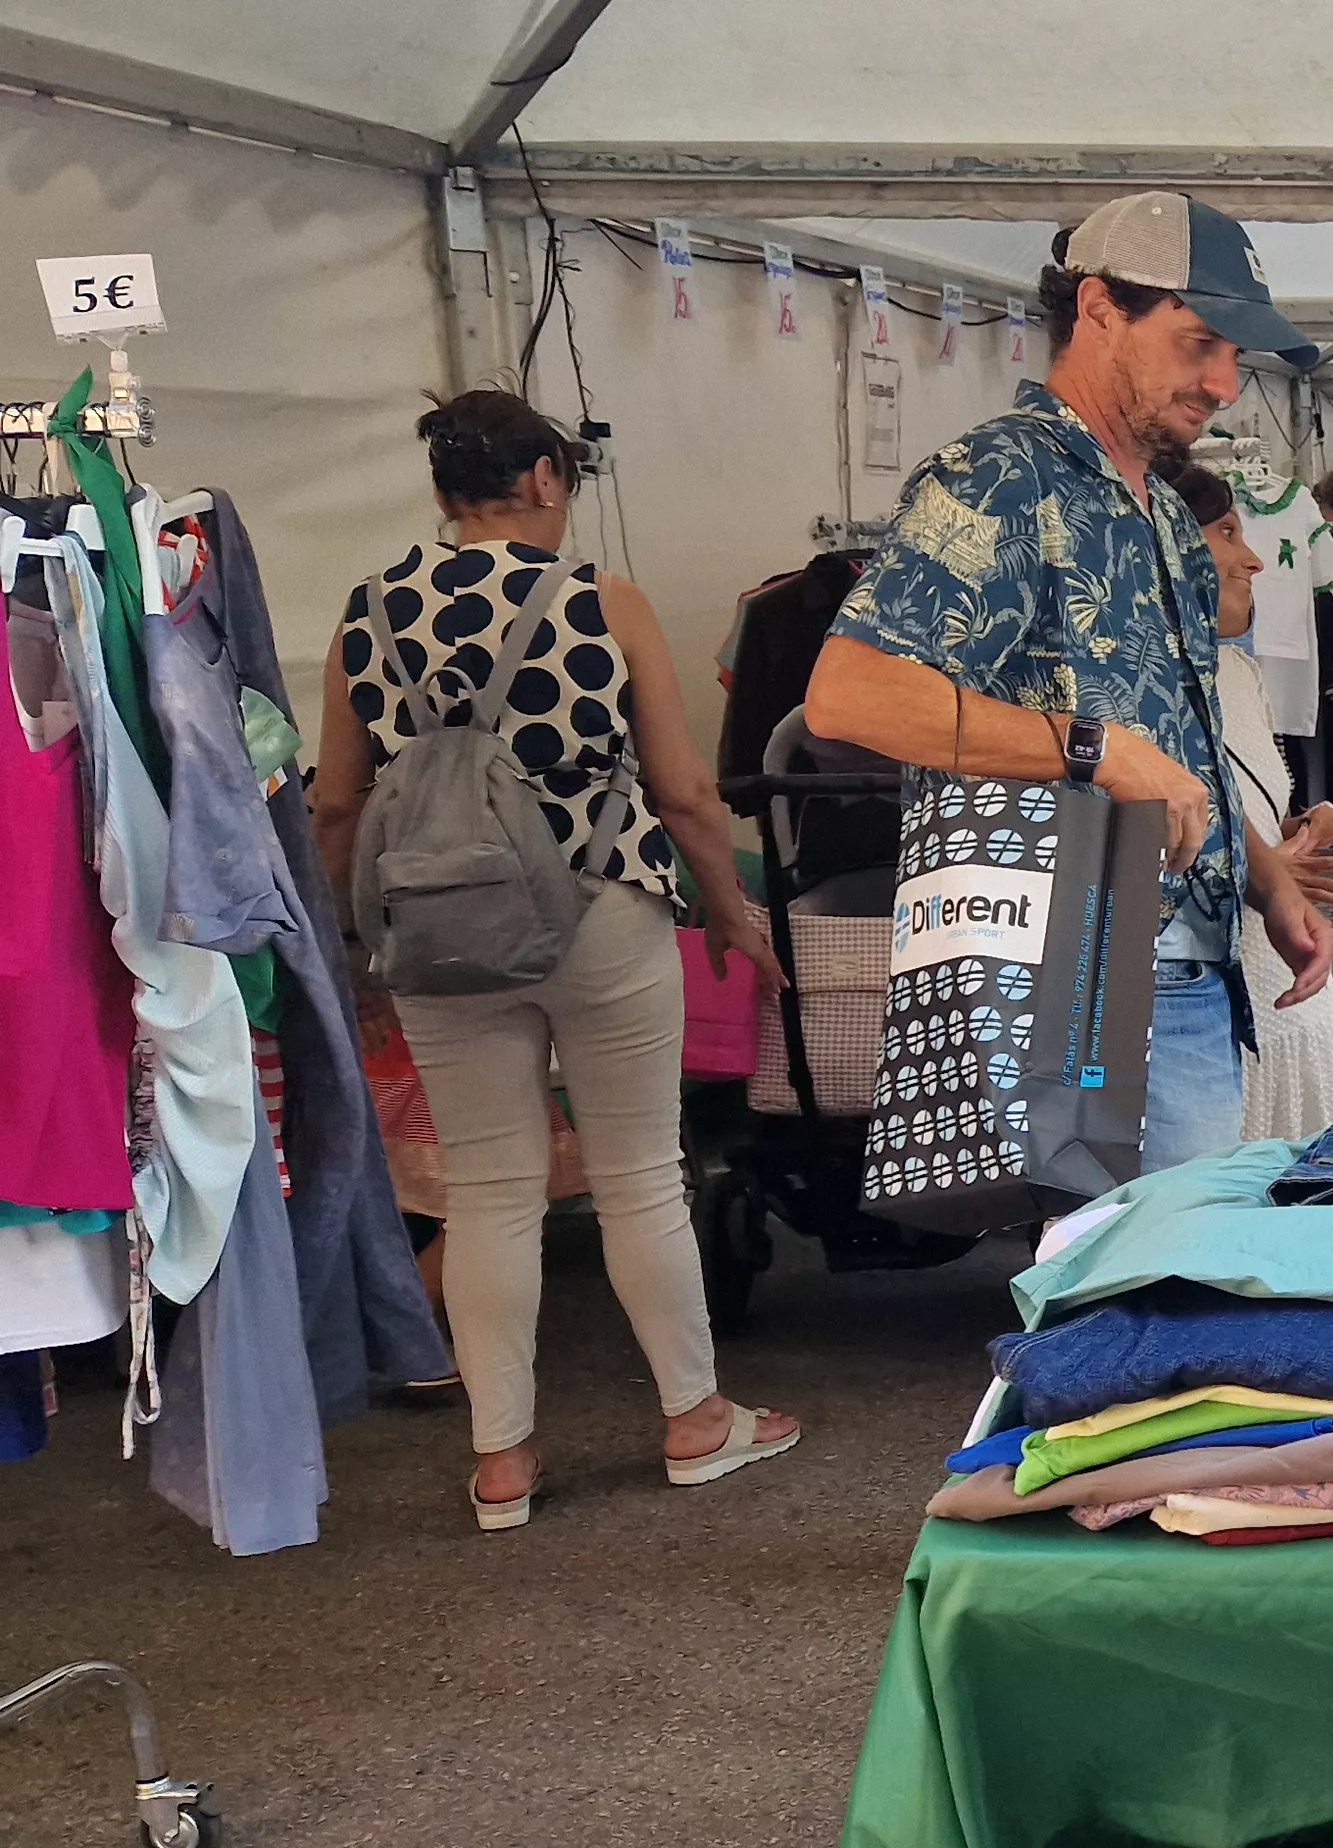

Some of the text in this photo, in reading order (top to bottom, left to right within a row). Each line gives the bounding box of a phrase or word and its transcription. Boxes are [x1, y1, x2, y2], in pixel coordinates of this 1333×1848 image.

[73, 275, 134, 313] 5€
[911, 893, 1032, 936] Different
[1084, 884, 1097, 926] HUESCA
[971, 927, 1005, 940] SPORT
